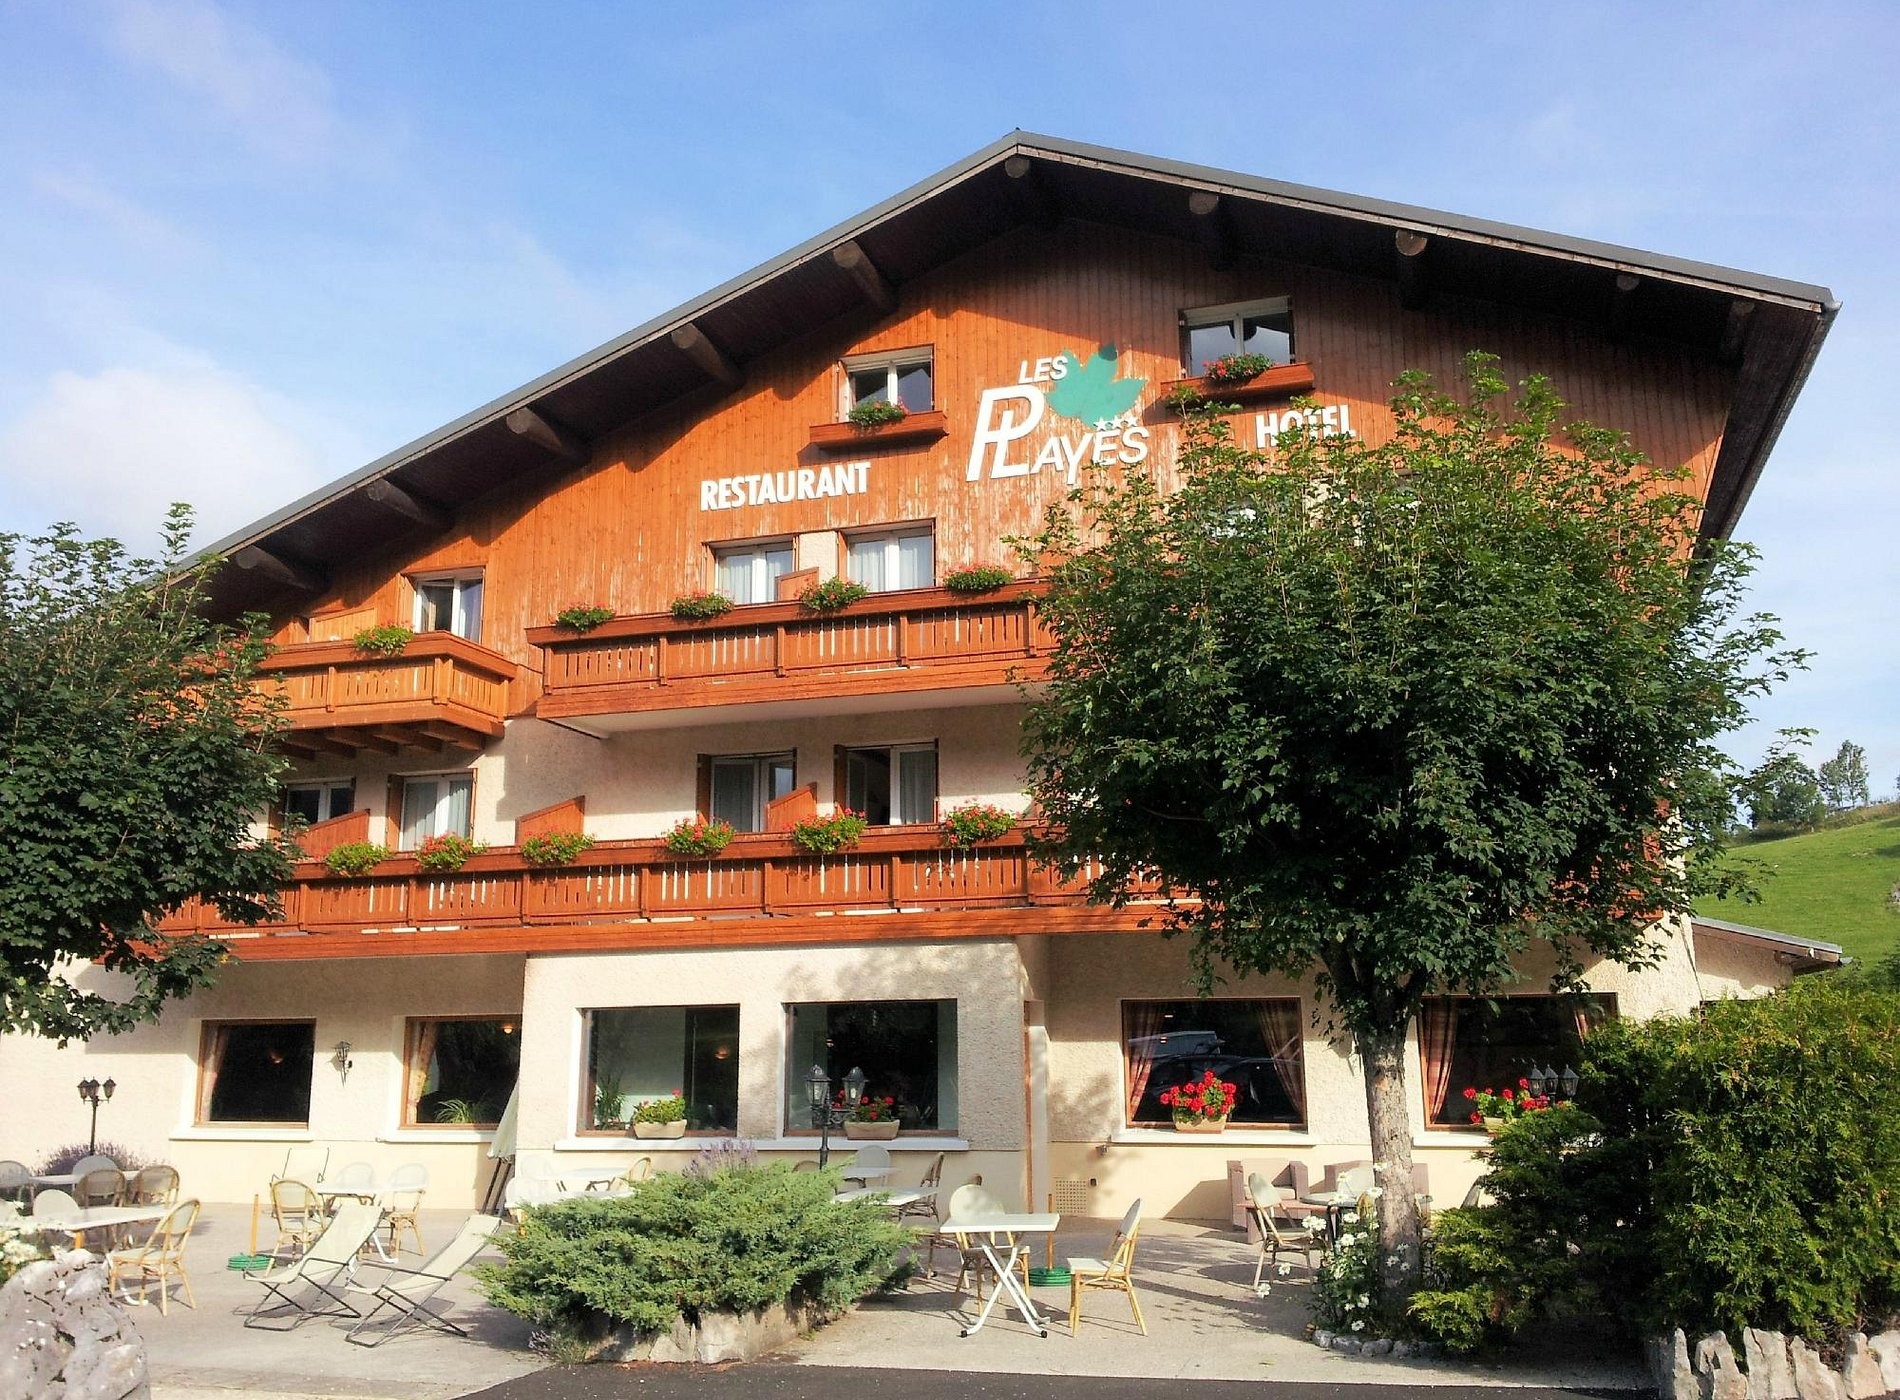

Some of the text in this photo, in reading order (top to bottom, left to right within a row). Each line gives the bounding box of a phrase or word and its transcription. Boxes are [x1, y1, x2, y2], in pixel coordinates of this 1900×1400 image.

[1018, 356, 1068, 384] LES
[965, 384, 1150, 485] PLAYES
[1255, 404, 1357, 449] HOTEL
[700, 461, 871, 511] RESTAURANT
